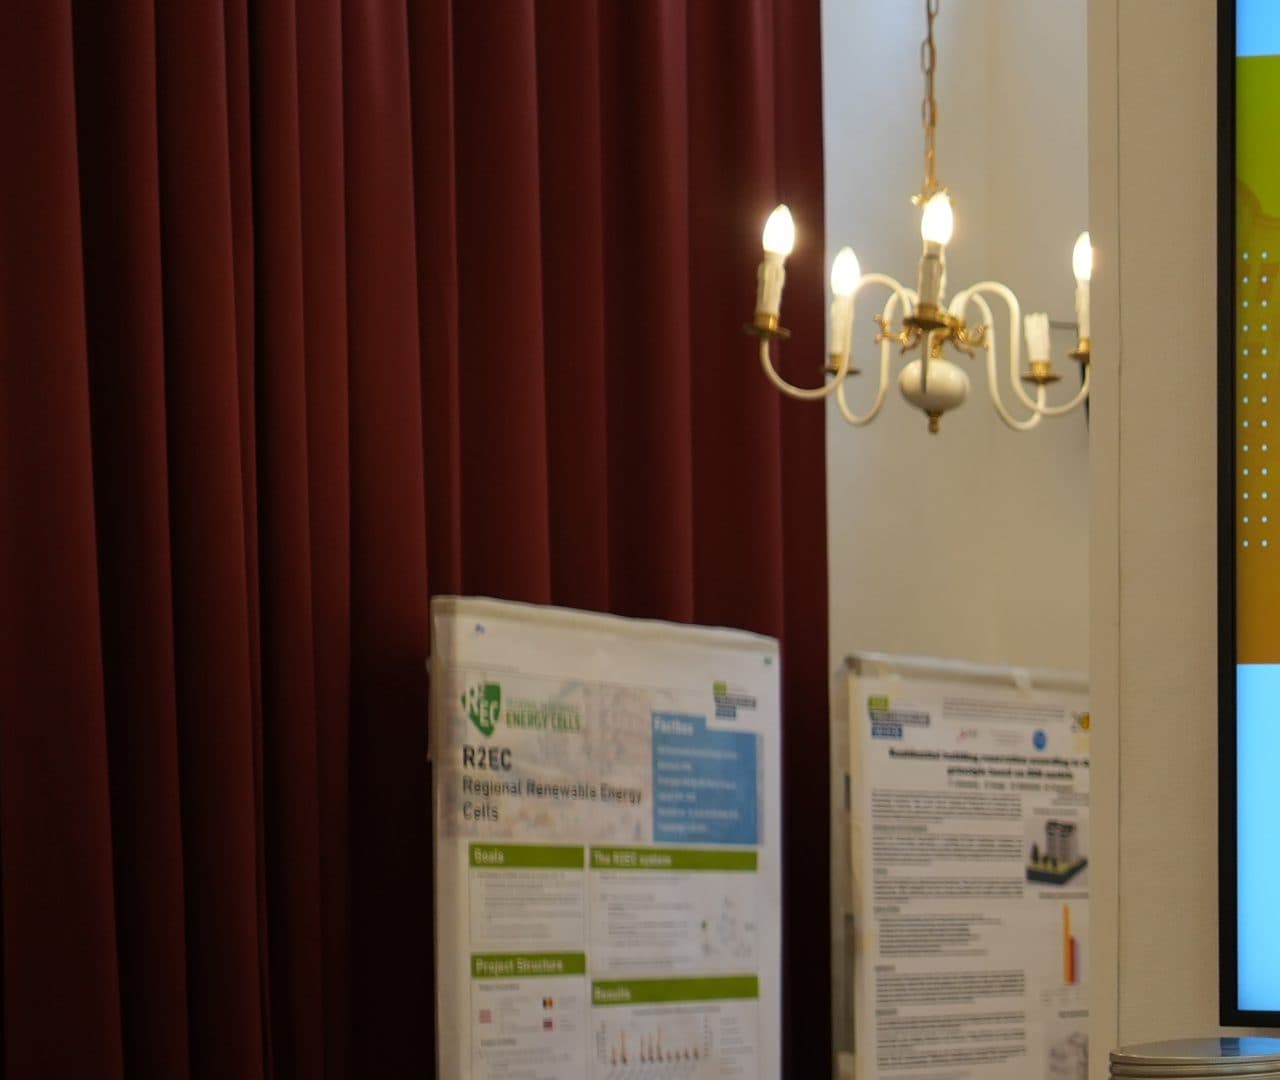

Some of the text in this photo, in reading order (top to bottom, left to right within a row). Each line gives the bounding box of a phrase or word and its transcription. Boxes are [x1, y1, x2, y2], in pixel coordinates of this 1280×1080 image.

[462, 745, 513, 771] R2EC
[462, 775, 643, 806] Regional Renewable Energy
[462, 801, 499, 822] Cells
[475, 957, 564, 977] Project Structure
